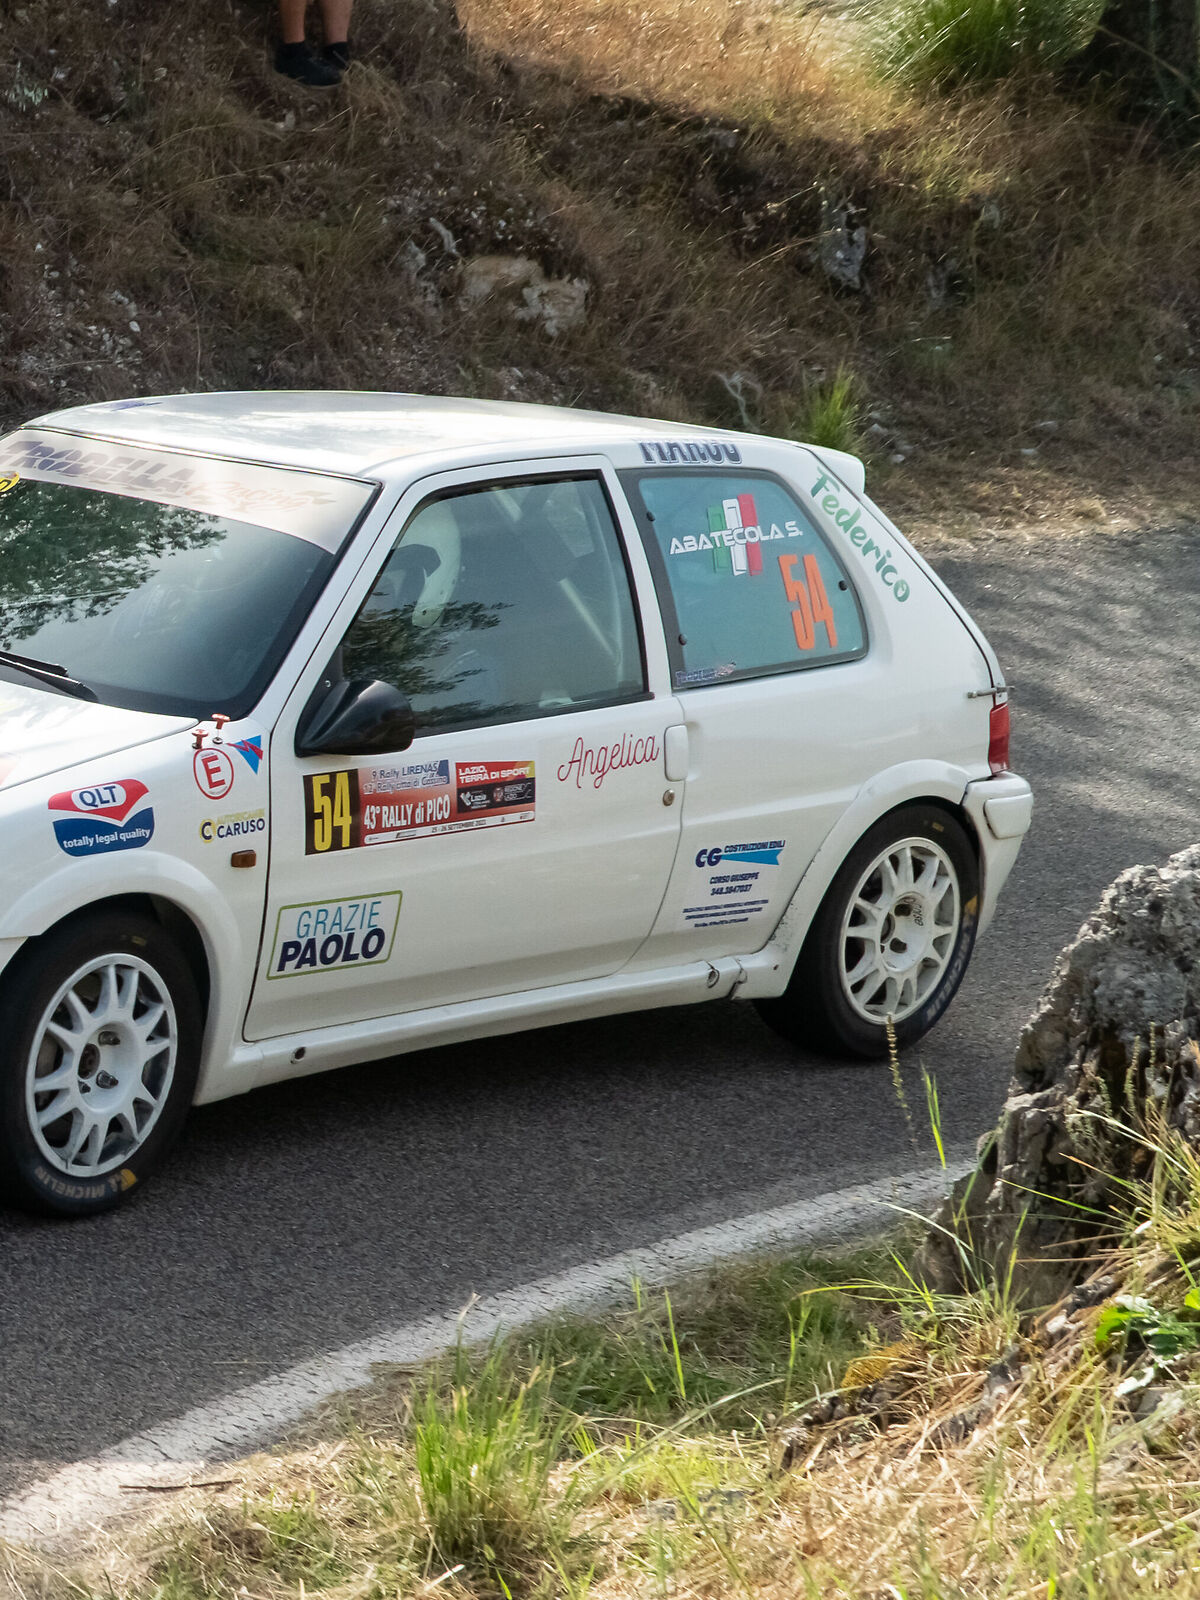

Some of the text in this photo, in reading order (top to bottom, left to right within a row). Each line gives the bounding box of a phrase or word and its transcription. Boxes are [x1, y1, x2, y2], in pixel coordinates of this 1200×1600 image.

[669, 525, 785, 555] ABATECOLA
[810, 466, 910, 603] Federico
[779, 554, 838, 650] 54
[201, 755, 226, 789] E
[380, 767, 399, 780] Rally
[402, 762, 438, 776] LIRENAS
[460, 774, 489, 783] TERRA
[501, 767, 531, 778] SPORT
[557, 733, 660, 789] Angelica
[79, 785, 116, 808] QLT
[312, 772, 352, 851] 54
[364, 794, 450, 829] 43° RALLY di PICO
[63, 827, 150, 849] totally legal quality
[217, 818, 265, 838] CARUSO
[695, 847, 722, 868] CG
[296, 901, 381, 938] GRAZIE
[277, 928, 385, 972] PAOLO
[35, 1166, 105, 1199] MICHELIN
